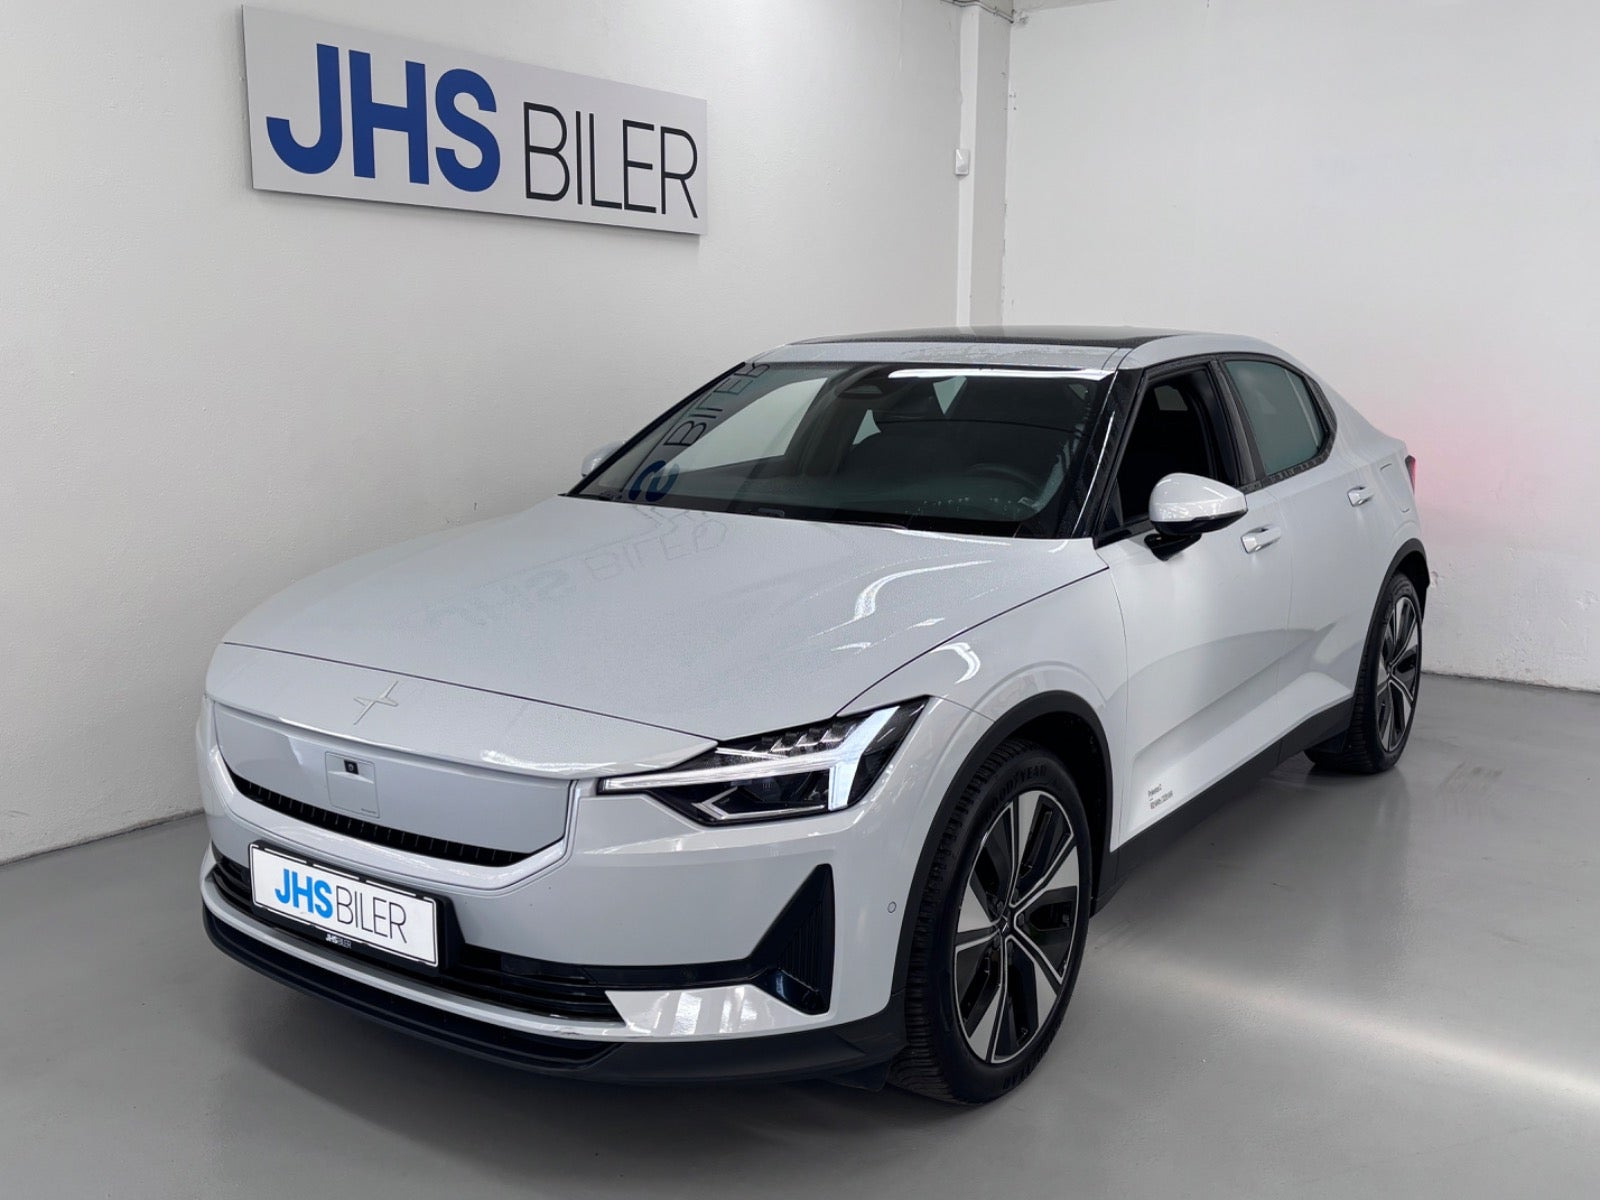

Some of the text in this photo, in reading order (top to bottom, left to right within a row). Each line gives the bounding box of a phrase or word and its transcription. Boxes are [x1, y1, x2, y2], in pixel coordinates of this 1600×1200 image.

[266, 43, 698, 219] JHS BILER
[274, 868, 407, 944] JHS BILER
